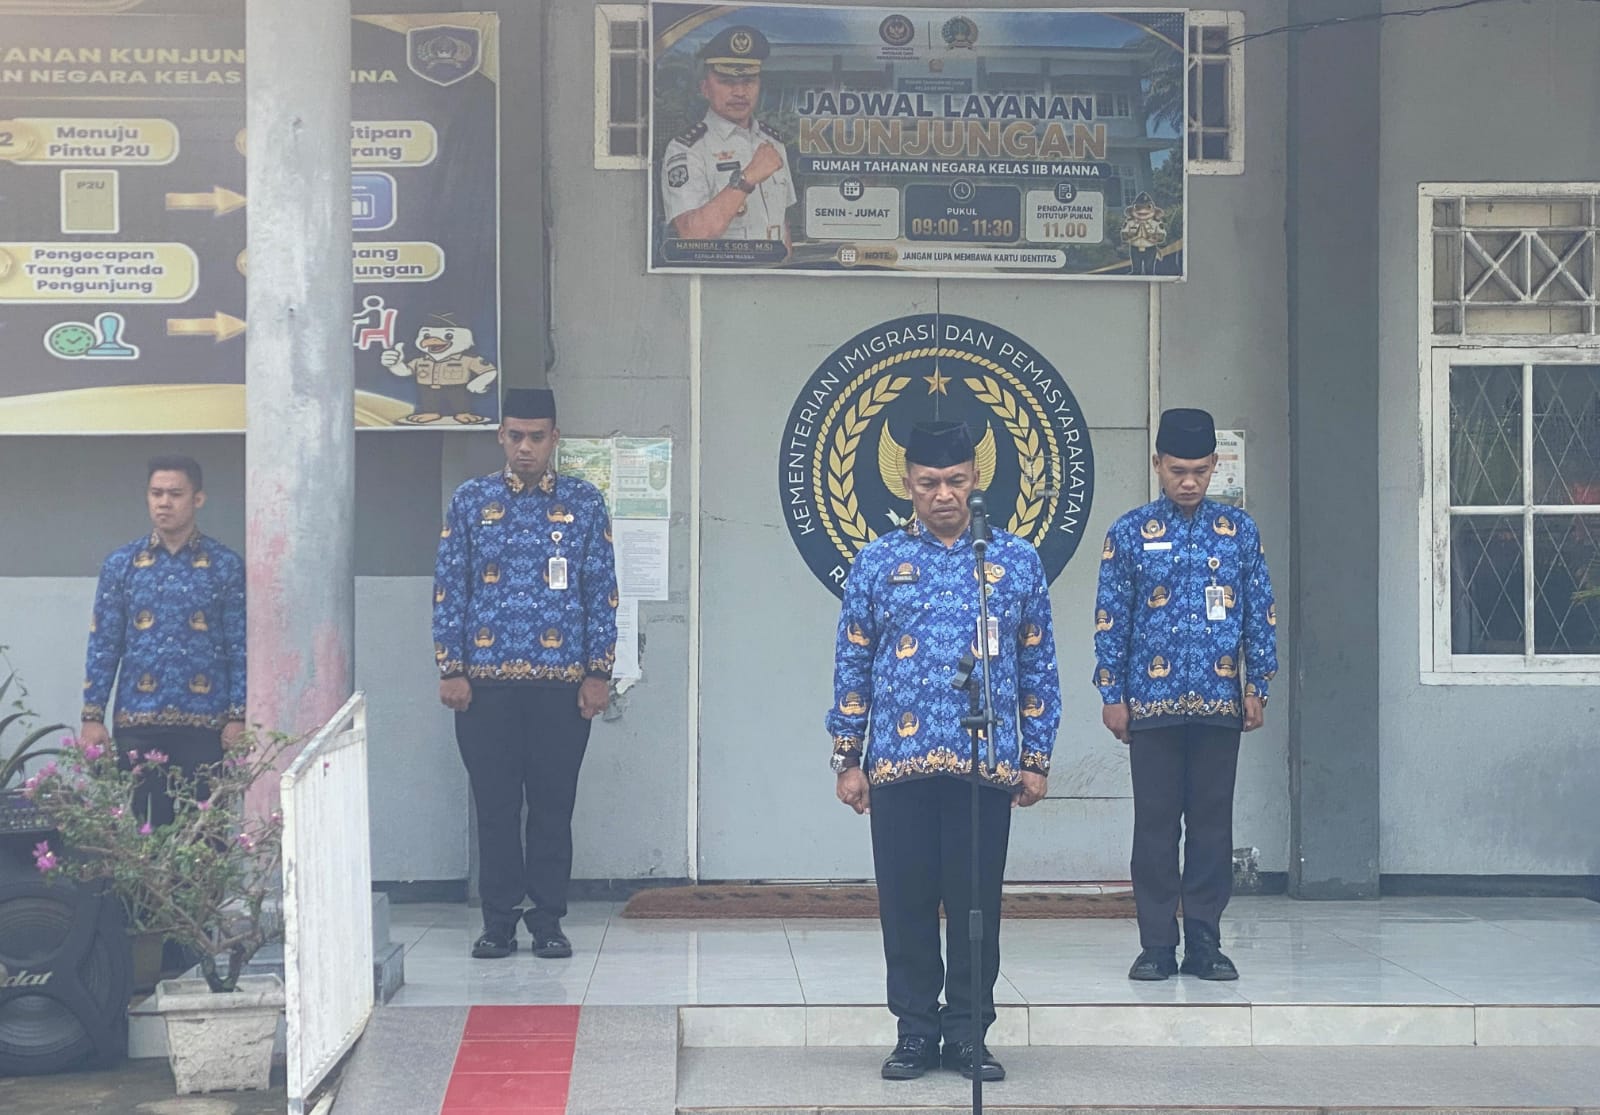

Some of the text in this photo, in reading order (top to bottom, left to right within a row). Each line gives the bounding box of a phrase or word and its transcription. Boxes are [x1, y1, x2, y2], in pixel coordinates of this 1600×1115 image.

[0, 48, 246, 64] ANAN KUNJUN
[30, 70, 147, 83] NEGARA
[155, 70, 241, 84] KELAS
[798, 91, 1094, 121] JADWAL LAYANAN
[0, 132, 14, 147] 2
[57, 127, 138, 142] Menuju
[799, 118, 1106, 159] KUNJUNGAN
[50, 144, 150, 156] Pintu P2U
[352, 147, 402, 160] rang
[812, 160, 1100, 176] RUMAH TAHANAN NEGARA KELAS IIB MANNA
[77, 181, 105, 190] P2U
[815, 208, 846, 217] SENIN
[855, 209, 890, 218] JUMAT
[947, 207, 977, 216] PUKUL
[912, 218, 958, 235] 09:00
[972, 219, 1013, 236] 11:30
[1043, 222, 1087, 238] 11.00
[34, 249, 154, 263] Pengecapan
[902, 251, 932, 260] JANGAN
[934, 252, 952, 260] LUPA
[954, 253, 992, 261] MEMBAWA
[994, 254, 1018, 262] KARTU
[1020, 254, 1057, 262] IDENTITAS
[26, 264, 163, 277] Tangan Tanda
[355, 265, 423, 278] ungan
[37, 279, 152, 293] Pengunjung
[788, 323, 1086, 535] KEMENTERIAN IMIGRASI DAN PEMASYARAKATAN
